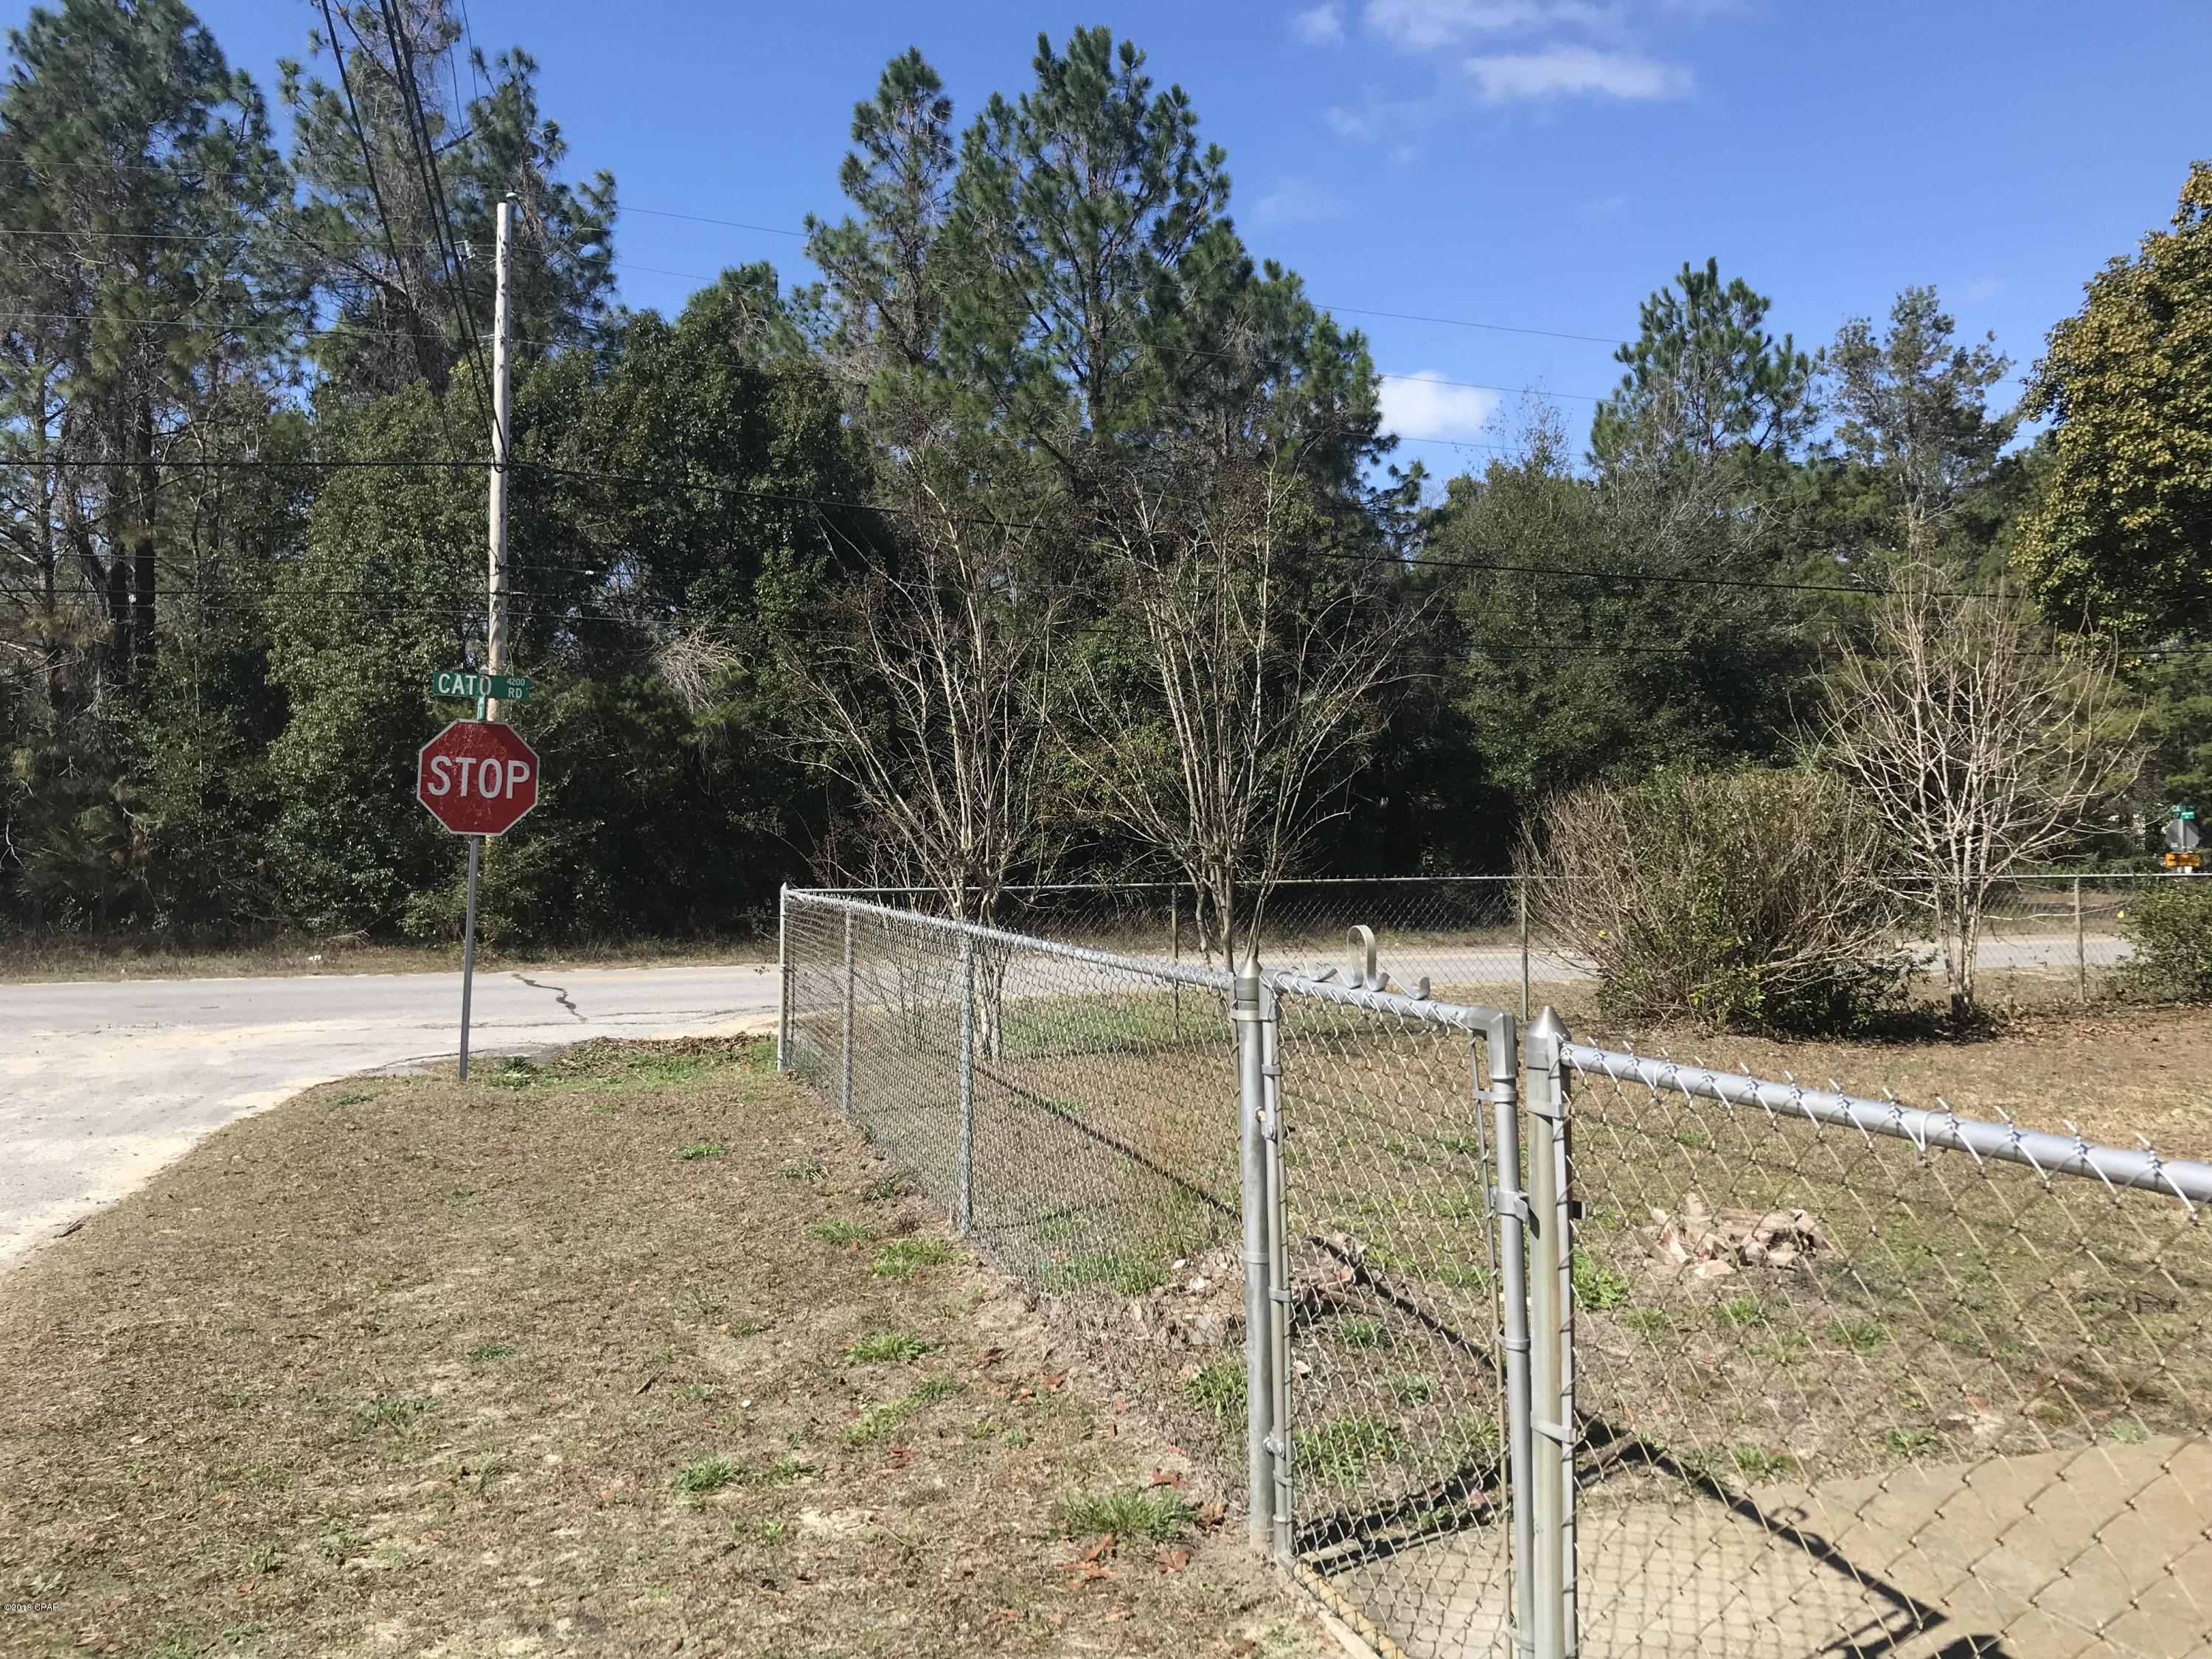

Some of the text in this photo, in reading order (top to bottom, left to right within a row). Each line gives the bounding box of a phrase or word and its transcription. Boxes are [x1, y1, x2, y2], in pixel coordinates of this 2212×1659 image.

[438, 673, 492, 695] CATO
[507, 678, 526, 686] 4200
[508, 688, 523, 698] RD
[428, 755, 530, 799] STOP
